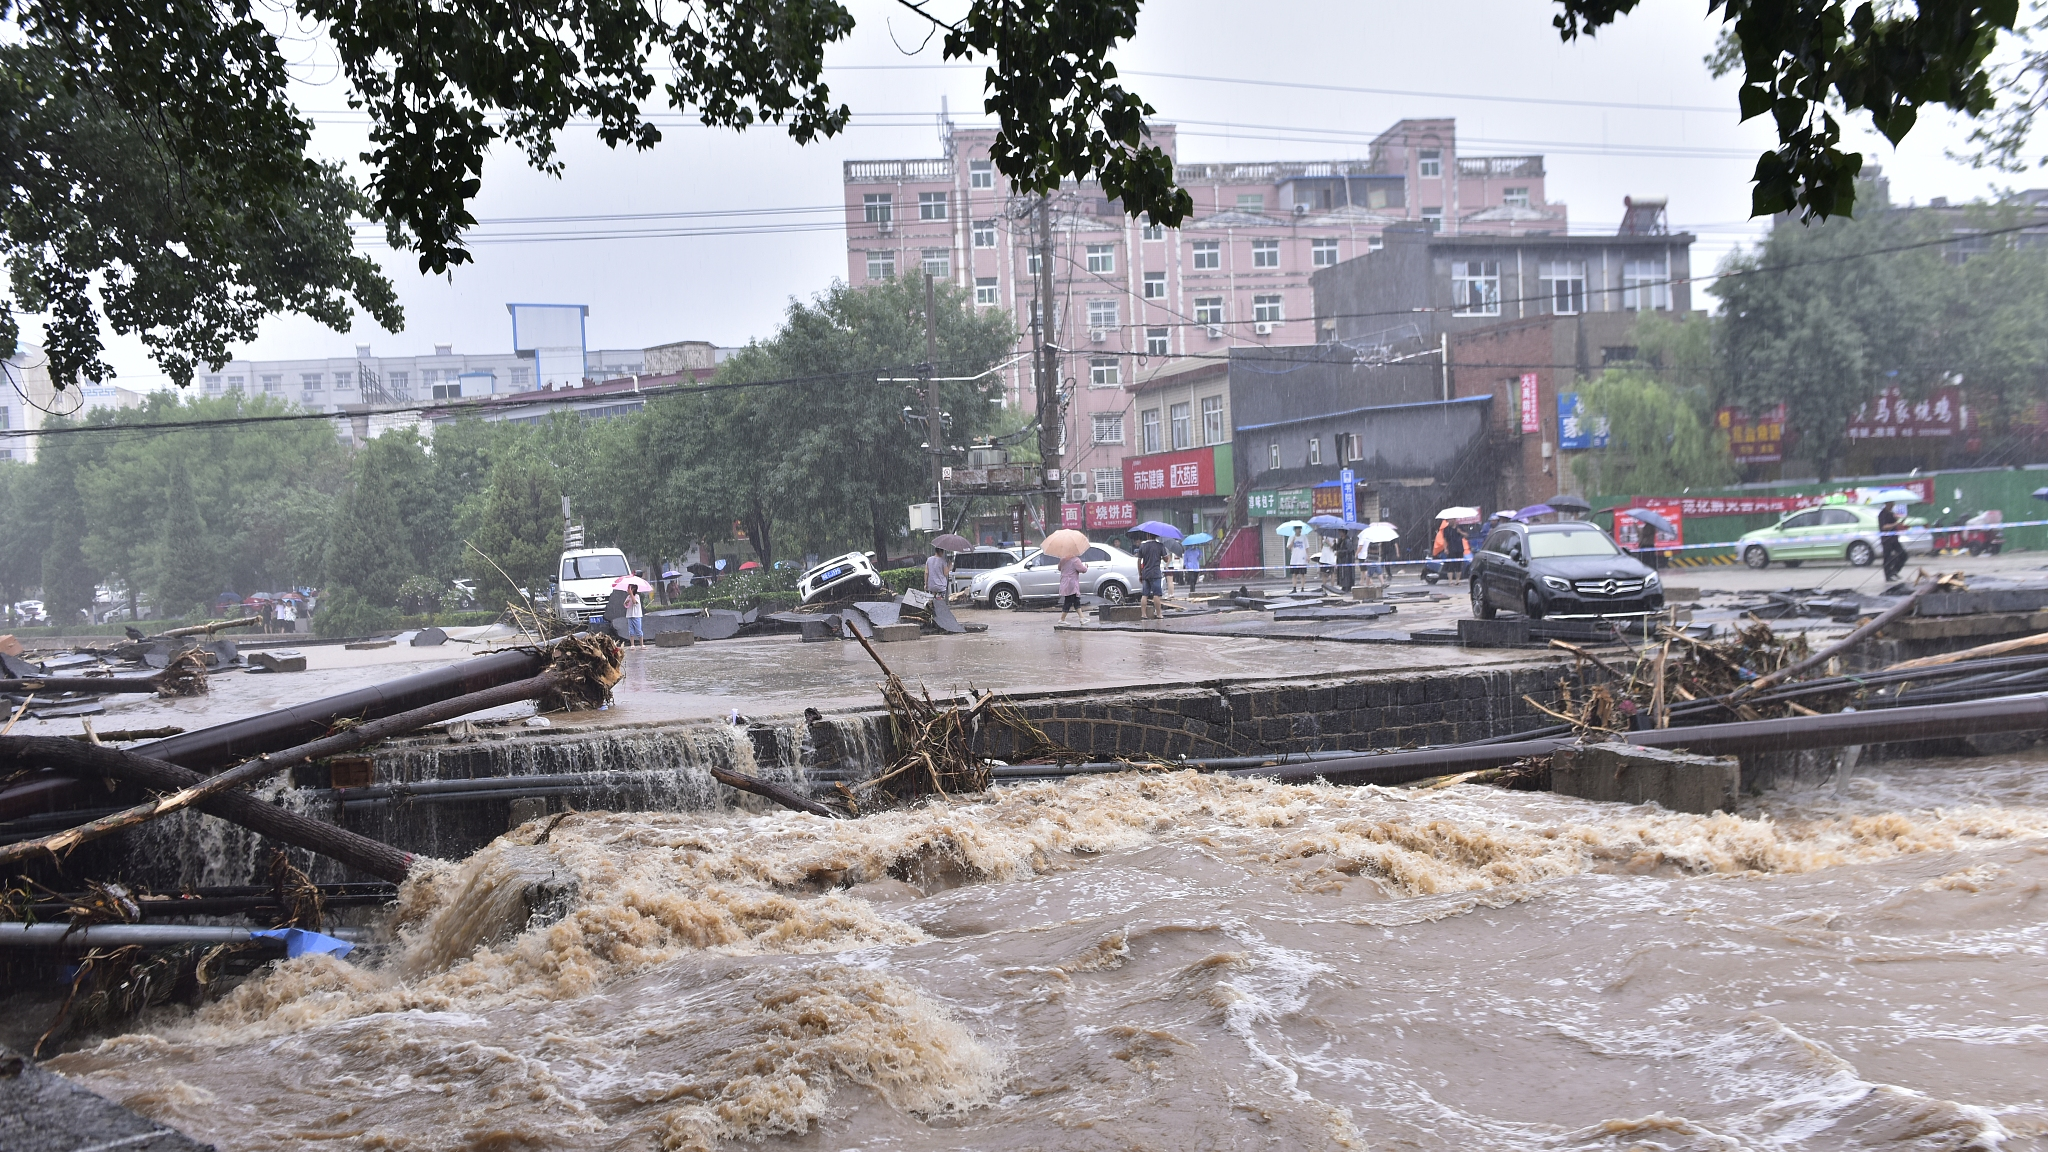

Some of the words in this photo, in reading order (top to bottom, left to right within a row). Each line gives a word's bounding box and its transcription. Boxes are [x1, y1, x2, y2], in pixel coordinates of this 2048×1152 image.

[1133, 469, 1165, 490] 京东健康
[1177, 465, 1198, 485] 大药房
[1095, 503, 1133, 520] 烧饼店
[1344, 484, 1354, 521] 书院河路
[1061, 508, 1078, 521] 面
